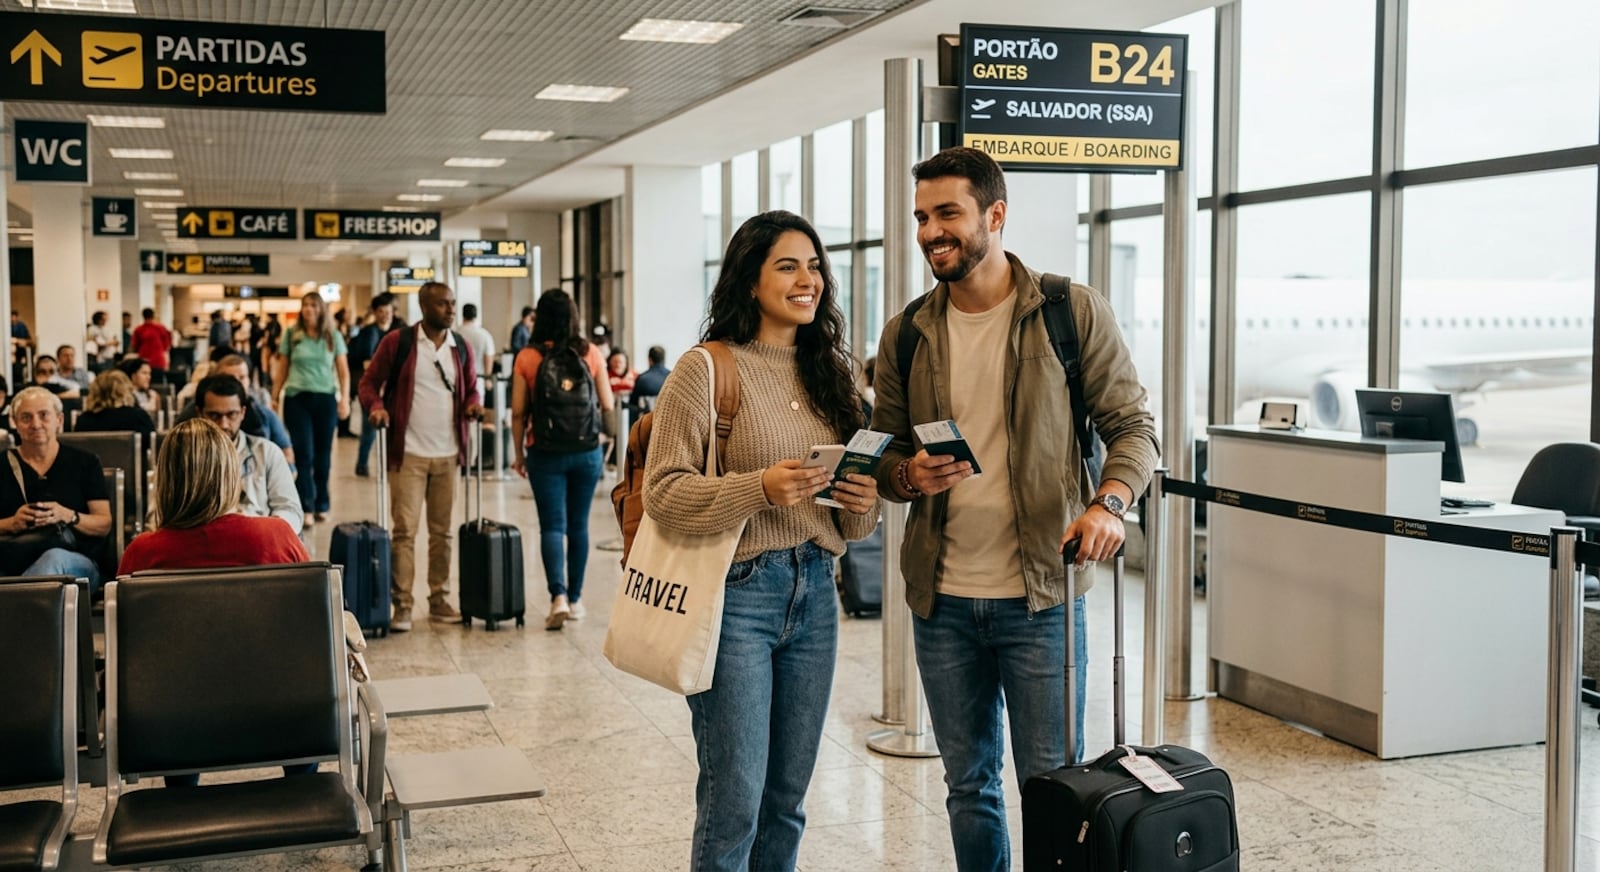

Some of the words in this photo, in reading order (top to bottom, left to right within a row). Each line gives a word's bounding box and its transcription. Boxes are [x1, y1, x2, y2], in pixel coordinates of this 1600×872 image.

[155, 36, 307, 66] PARTIDAS
[973, 38, 1058, 60] PORTÃO
[973, 63, 1028, 80] GATES
[1090, 42, 1175, 86] B24
[156, 66, 317, 97] Departures
[1006, 100, 1102, 120] SALVADOR
[1106, 104, 1154, 125] (SSA)
[21, 138, 83, 168] WC
[972, 139, 1069, 157] EMBARQUE
[1084, 143, 1172, 159] BOARDING
[240, 212, 289, 233] CAFÉ
[344, 217, 437, 236] FREESHOP
[625, 567, 688, 615] TRAVEL
